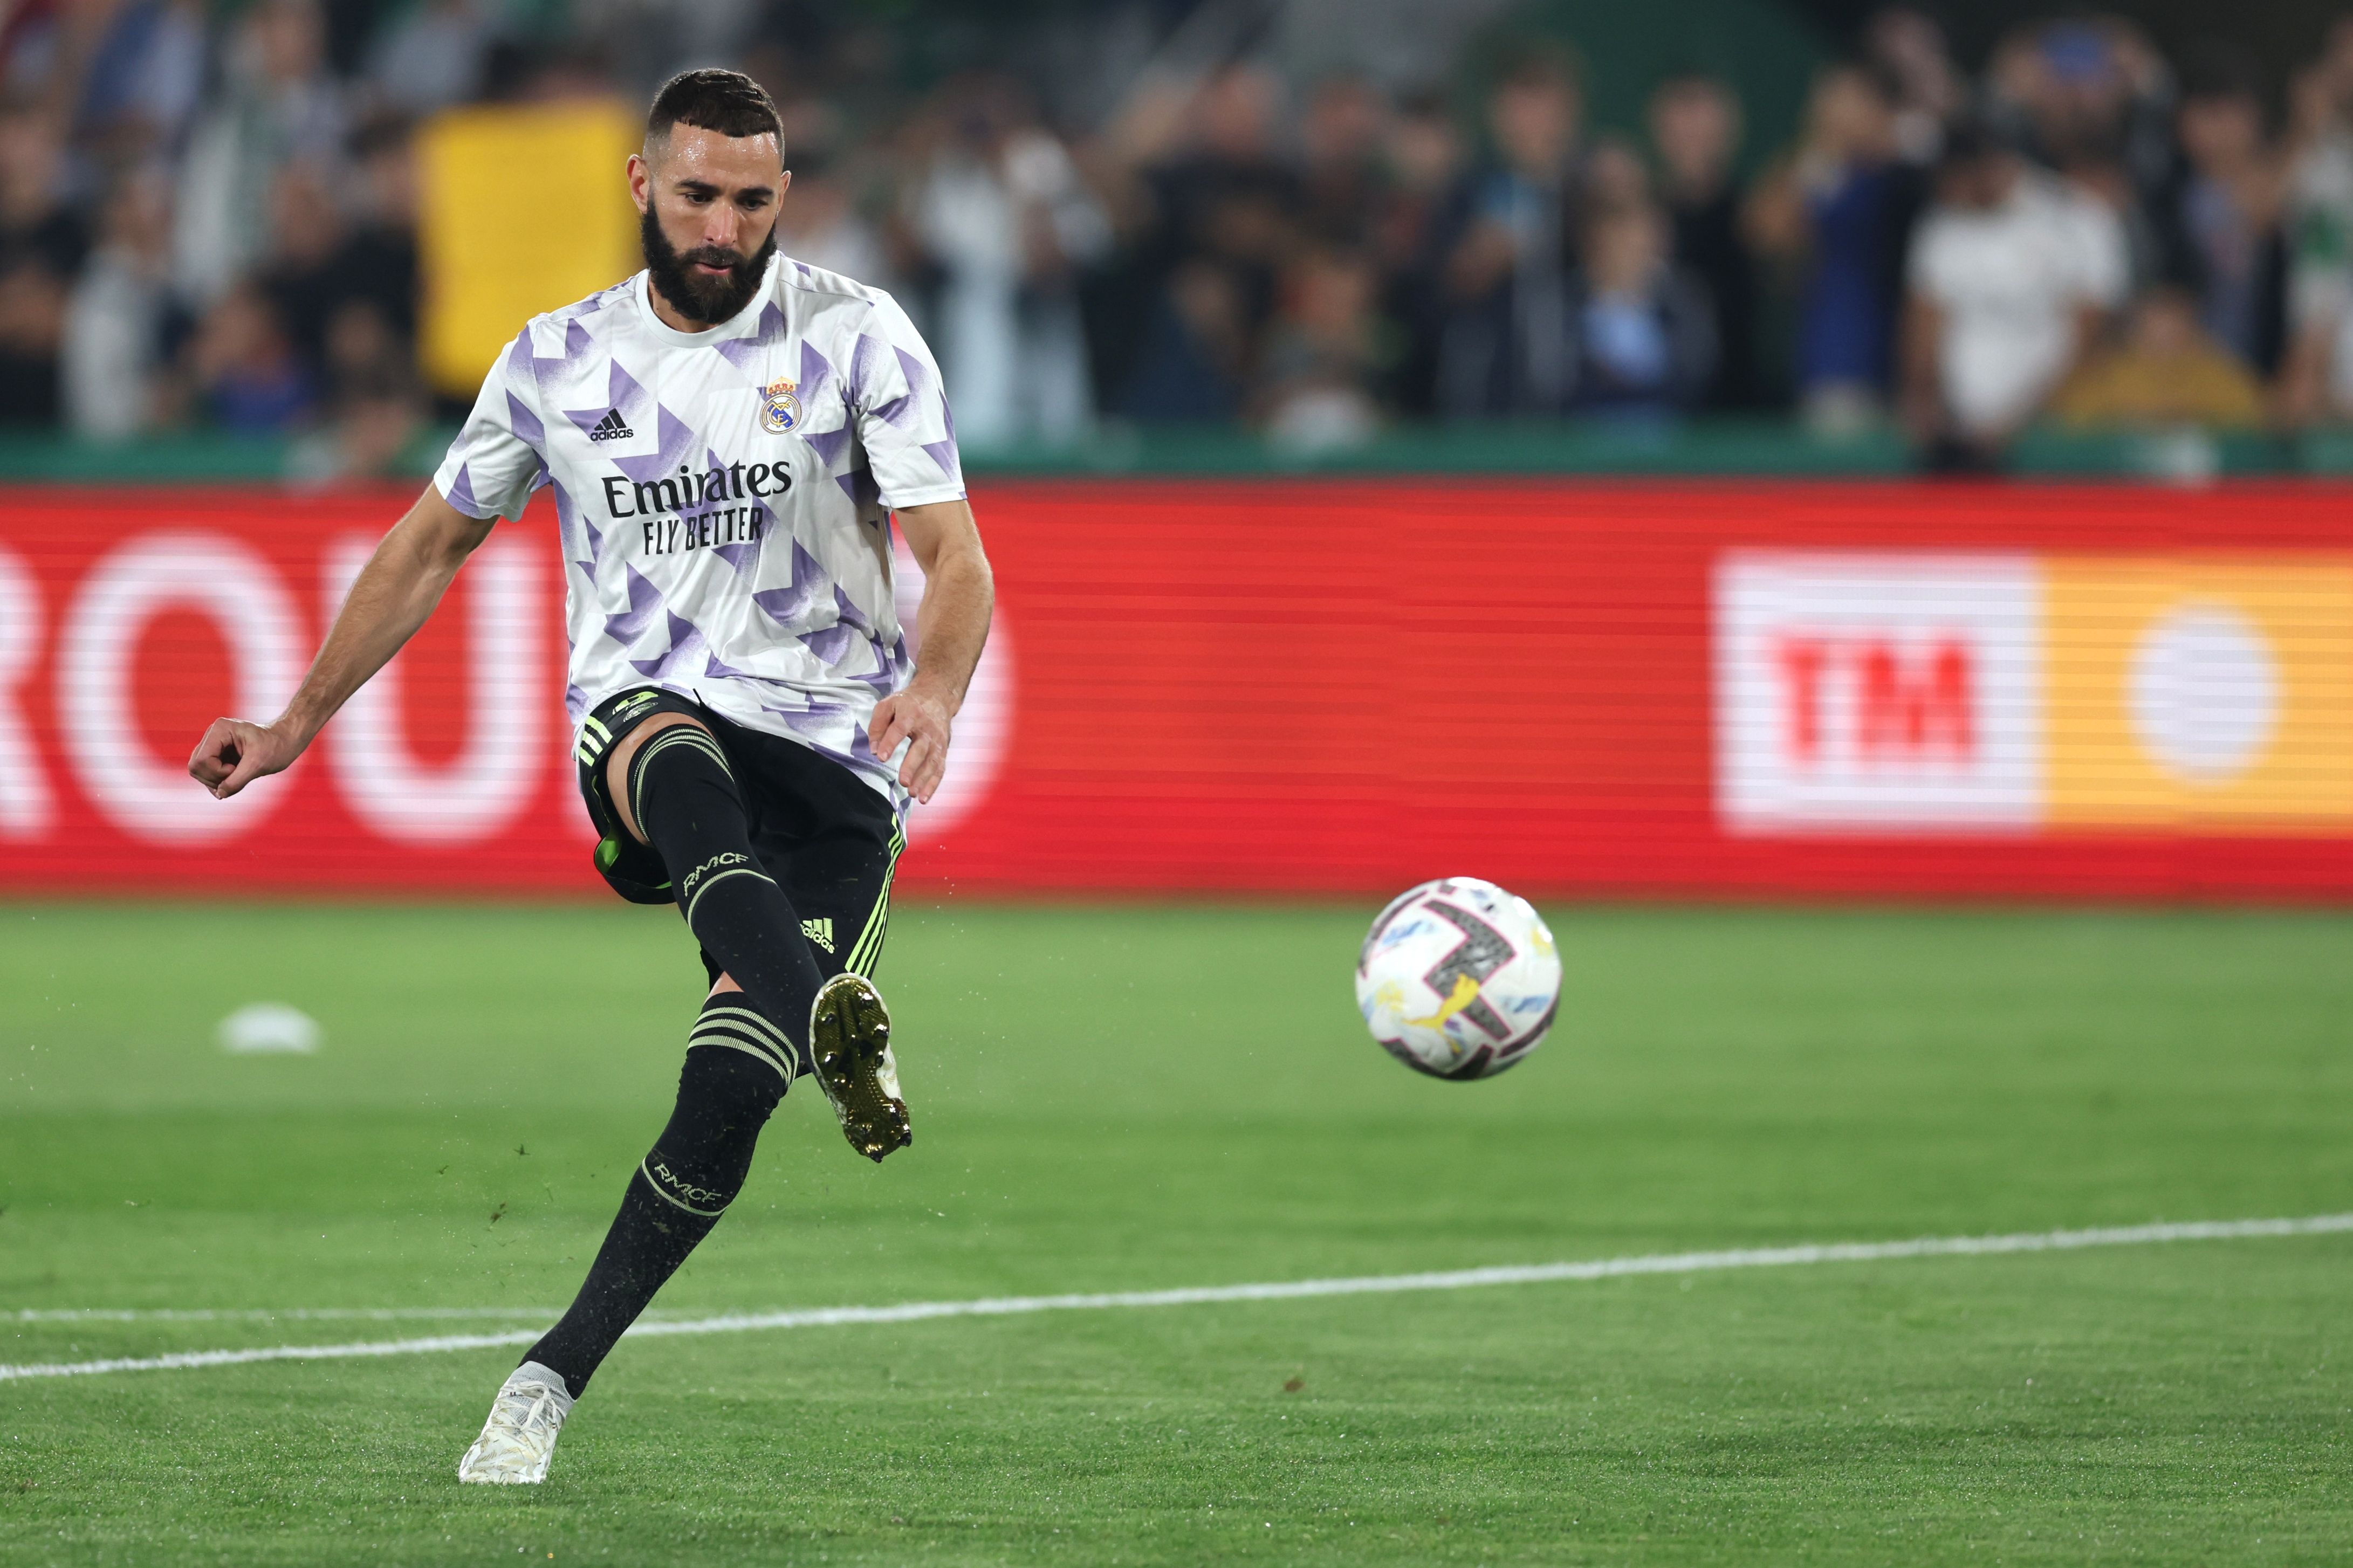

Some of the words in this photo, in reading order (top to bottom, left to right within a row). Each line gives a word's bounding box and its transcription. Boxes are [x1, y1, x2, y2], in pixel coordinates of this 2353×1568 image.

[591, 429, 633, 441] adidas
[601, 459, 792, 518] Emirates
[643, 519, 680, 555] FLY
[685, 507, 763, 551] BETTER
[1772, 635, 1976, 762] TM
[683, 852, 749, 897] RMCF
[799, 923, 835, 954] didas
[654, 1163, 722, 1203] RMCF
